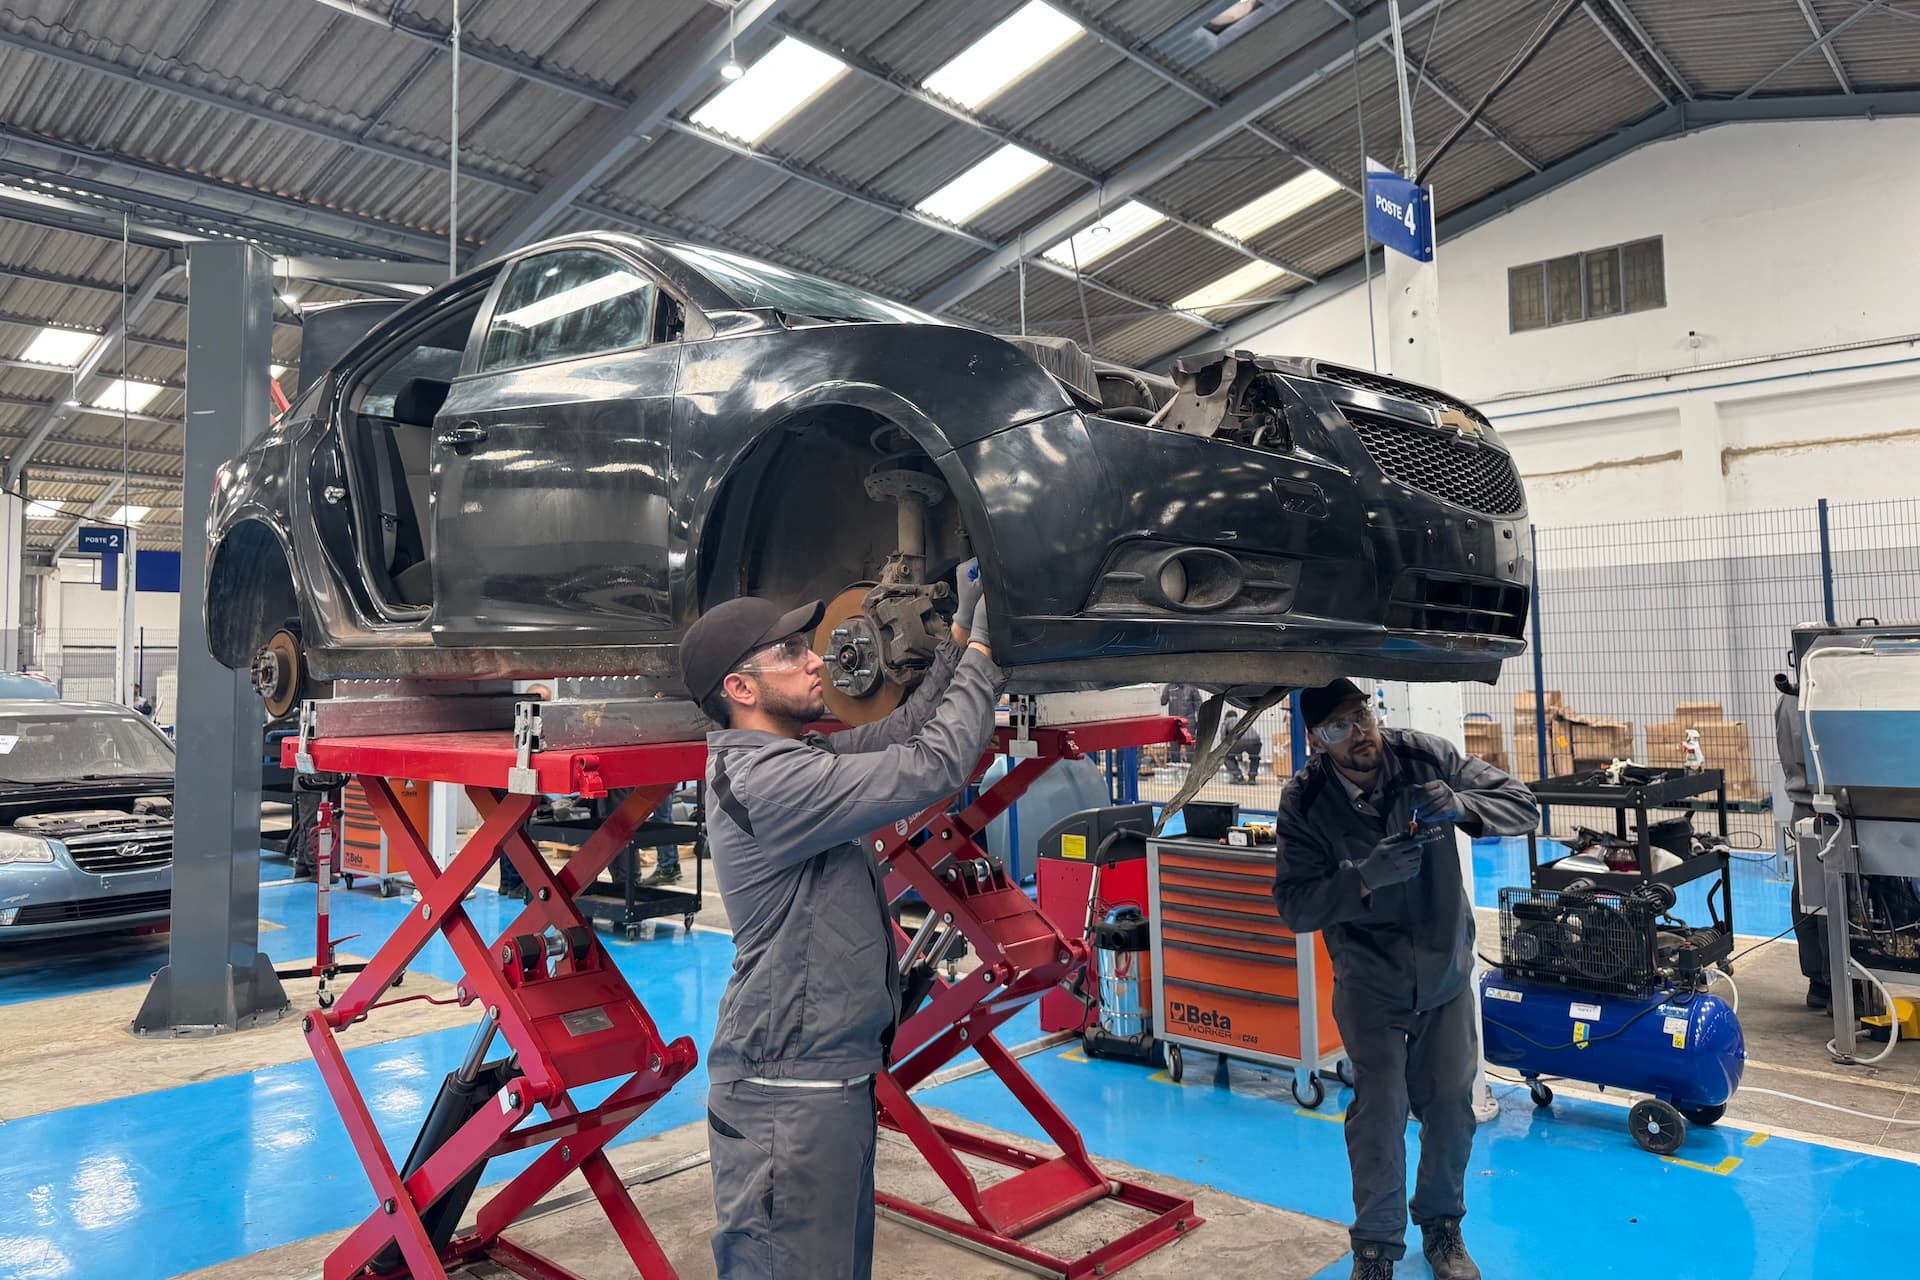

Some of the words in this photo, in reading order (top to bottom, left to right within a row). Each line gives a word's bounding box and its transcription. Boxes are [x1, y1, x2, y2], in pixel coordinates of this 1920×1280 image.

[1375, 194, 1403, 221] POSTE
[1404, 202, 1416, 236] 4
[109, 535, 118, 547] 2
[1187, 1005, 1231, 1030] Beta
[1187, 1024, 1232, 1039] WORKER
